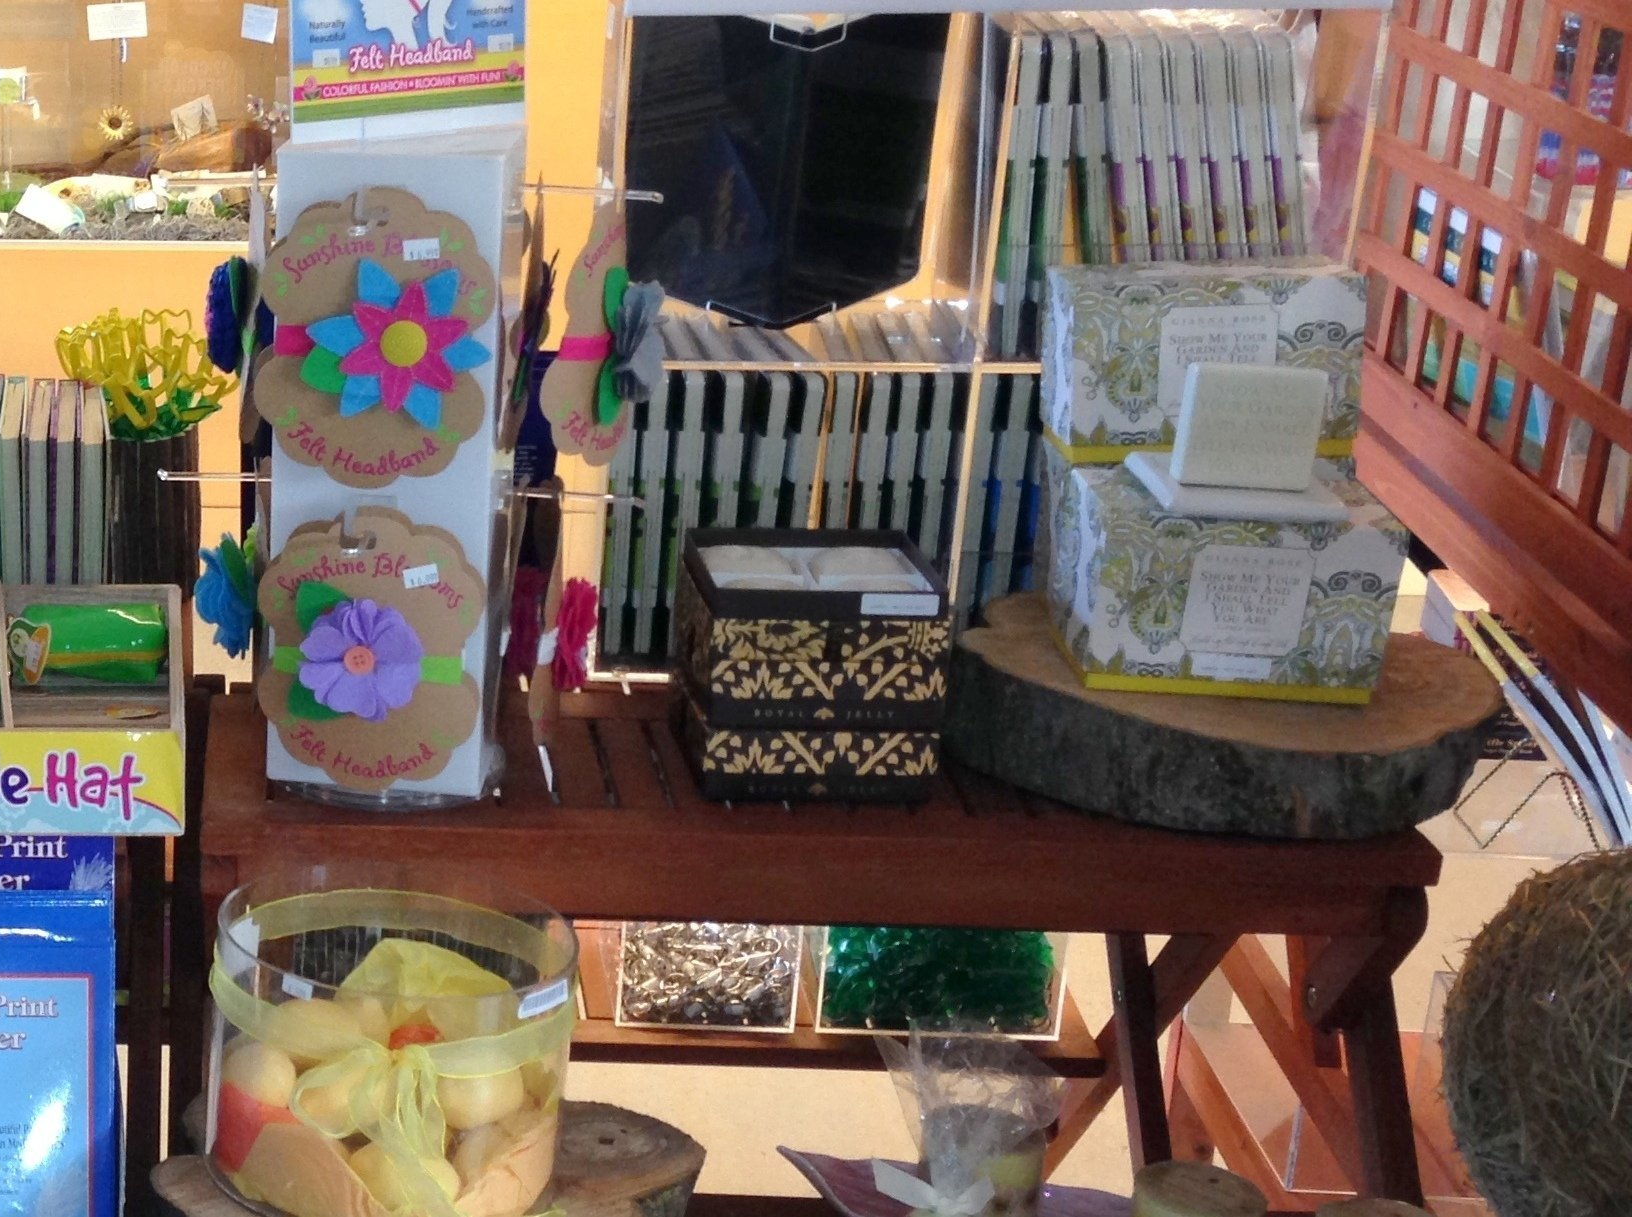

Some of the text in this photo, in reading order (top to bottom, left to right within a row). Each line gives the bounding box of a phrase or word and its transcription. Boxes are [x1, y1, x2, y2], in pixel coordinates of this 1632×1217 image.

[309, 20, 346, 32] Naturally
[349, 39, 474, 73] Felt Headband
[281, 232, 376, 284] Sunshine
[286, 420, 441, 476] Felt Headband
[276, 552, 465, 610] Sunshine Blms
[289, 724, 437, 779] Felt Headband
[44, 750, 144, 822] Hat
